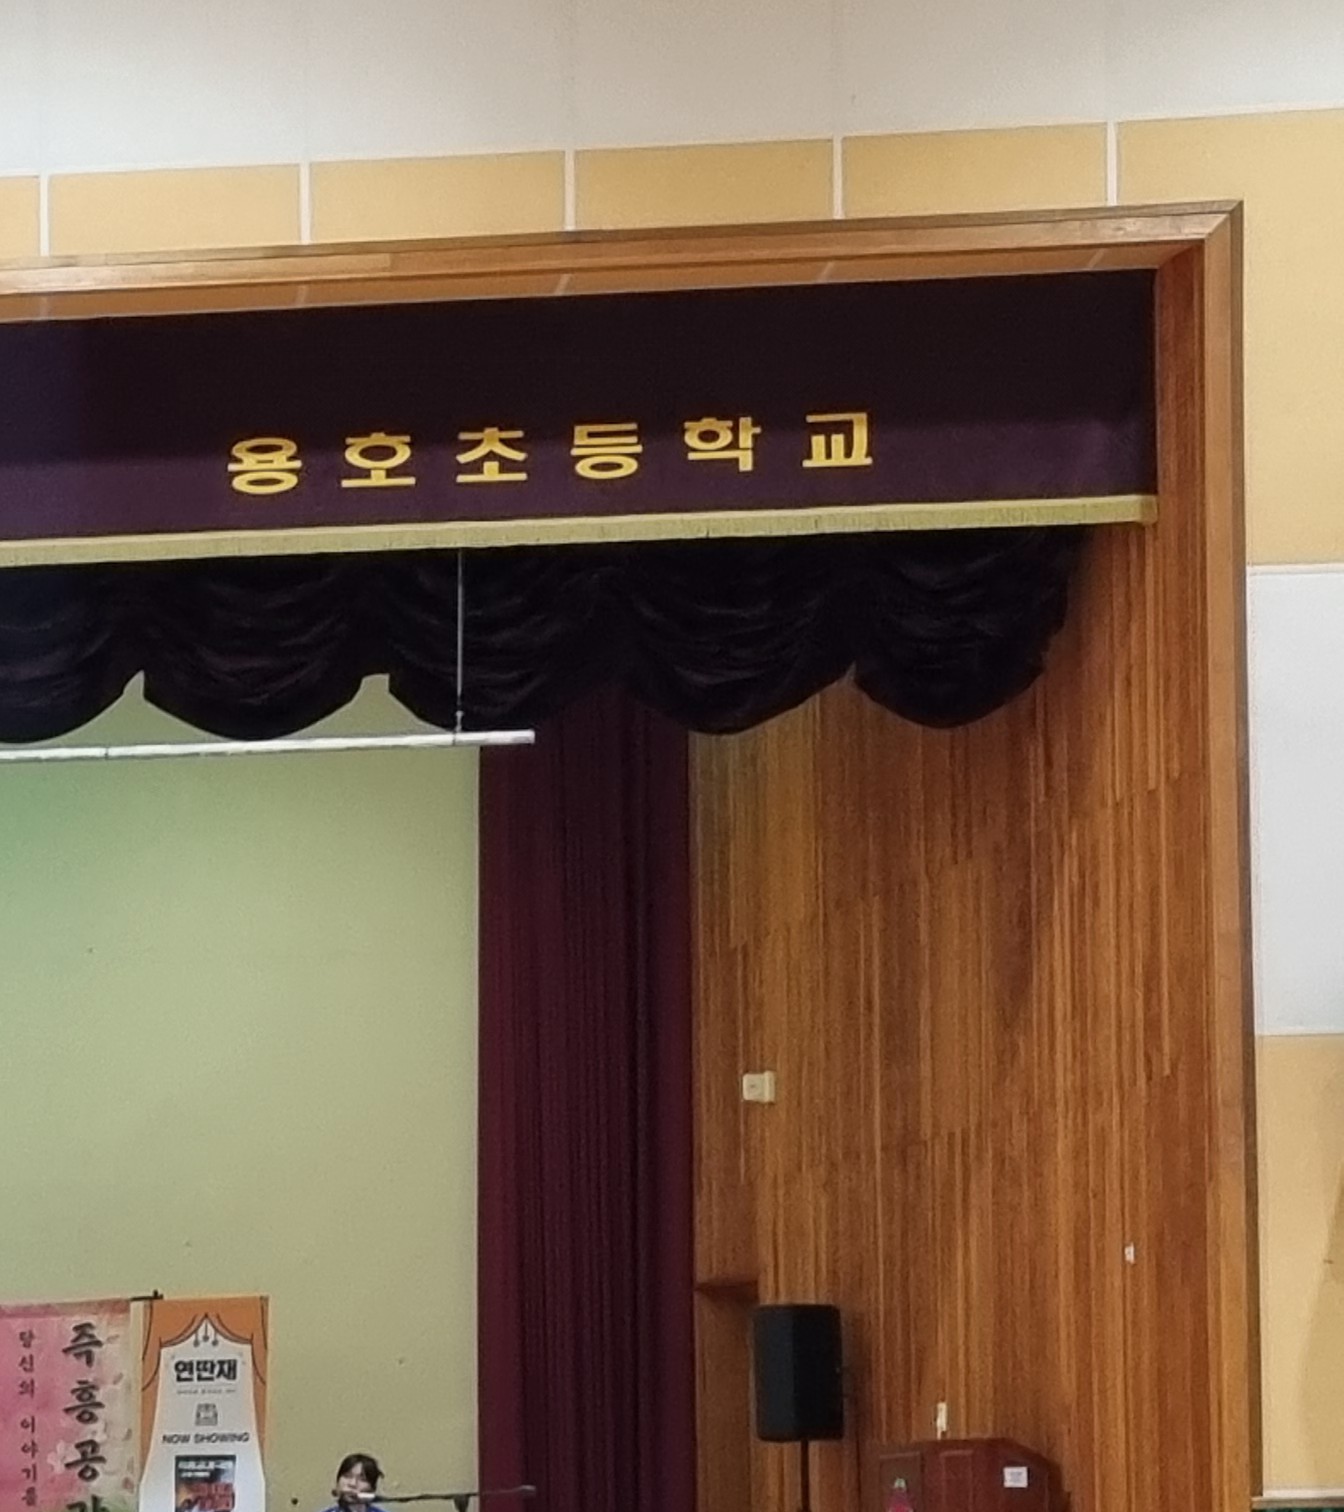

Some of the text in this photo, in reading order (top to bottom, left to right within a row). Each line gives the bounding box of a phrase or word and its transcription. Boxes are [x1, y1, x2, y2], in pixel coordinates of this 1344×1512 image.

[228, 410, 874, 495] 용호초등학교
[18, 1329, 36, 1399] 당신의
[174, 1358, 237, 1383] 연딴재
[20, 1414, 40, 1507] 이야기를
[162, 1433, 191, 1445] NOW
